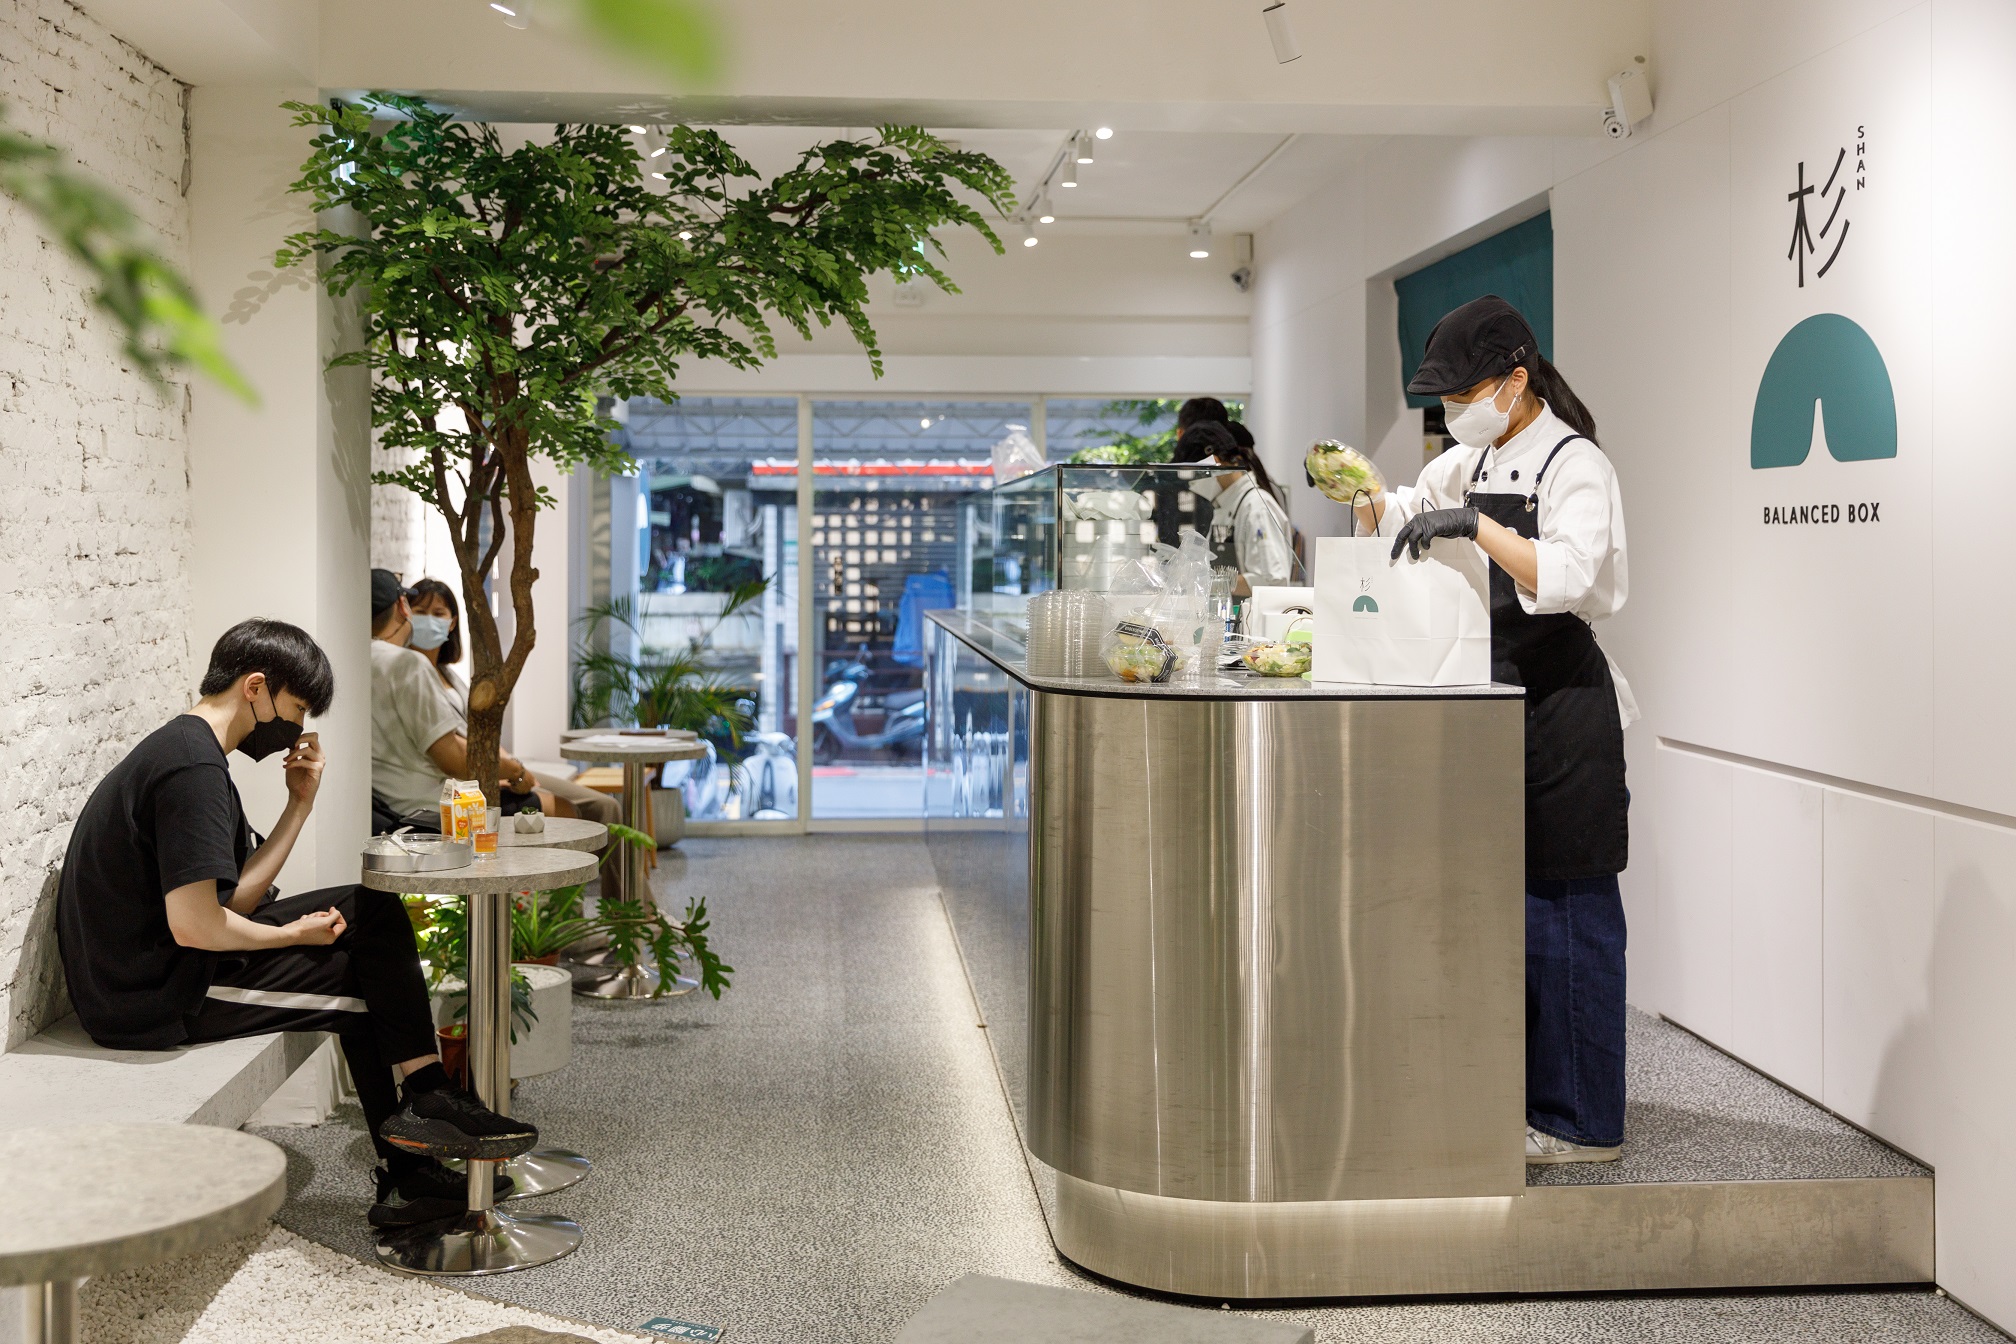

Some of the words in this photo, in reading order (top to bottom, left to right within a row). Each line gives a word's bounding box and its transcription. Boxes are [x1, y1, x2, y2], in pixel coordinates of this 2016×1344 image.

[1856, 125, 1866, 191] SHAN
[1787, 146, 1851, 288] 杉
[1763, 504, 1840, 525] BALANCED
[1848, 502, 1880, 523] BOX
